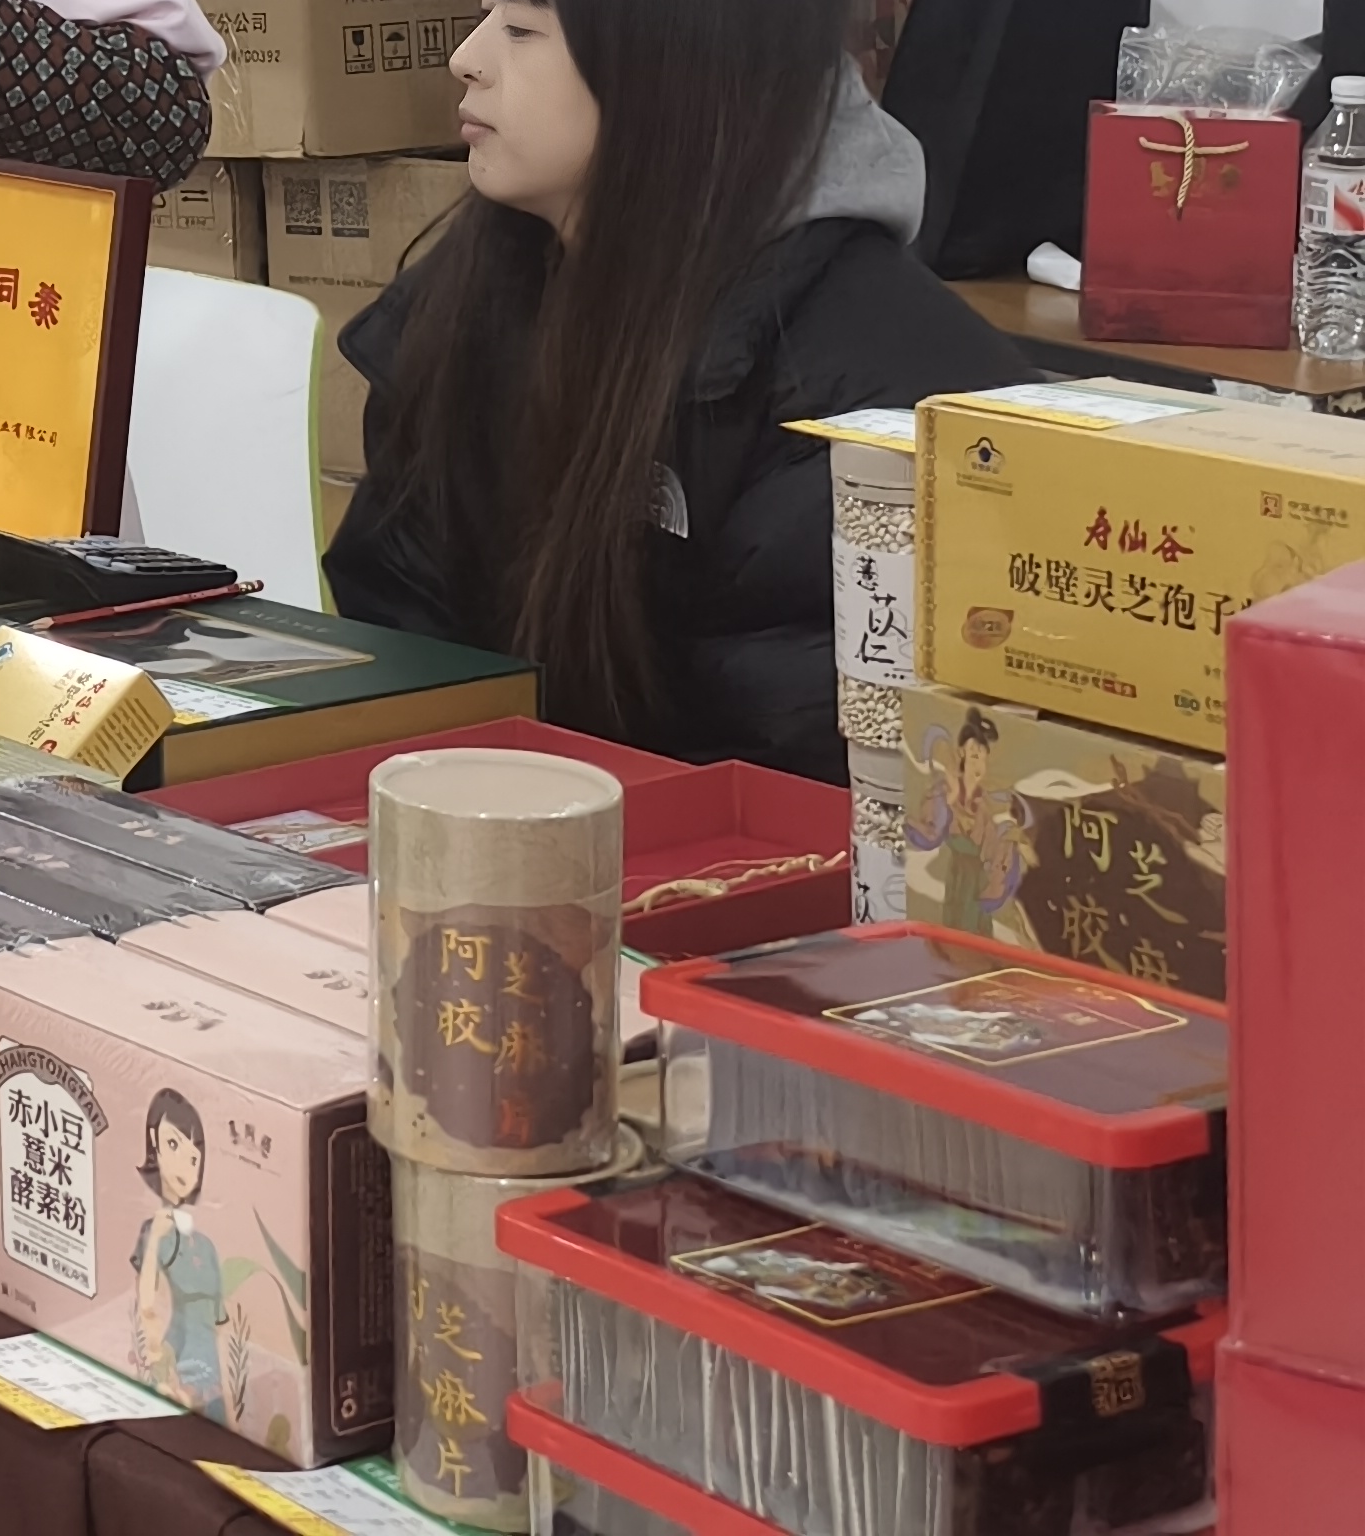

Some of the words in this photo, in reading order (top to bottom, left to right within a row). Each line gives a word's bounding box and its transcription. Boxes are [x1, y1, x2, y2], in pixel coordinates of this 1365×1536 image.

[1084, 505, 1194, 563] 寿仙谷
[1008, 552, 1253, 636] 破壁灵芝孢子
[1062, 798, 1129, 975] 阿胶
[437, 928, 499, 1053] 阿胶
[8, 1089, 87, 1156] 赤小豆
[22, 1132, 73, 1186] 薏米
[9, 1167, 87, 1236] 酵素粉
[433, 1301, 489, 1499] 芝麻片
